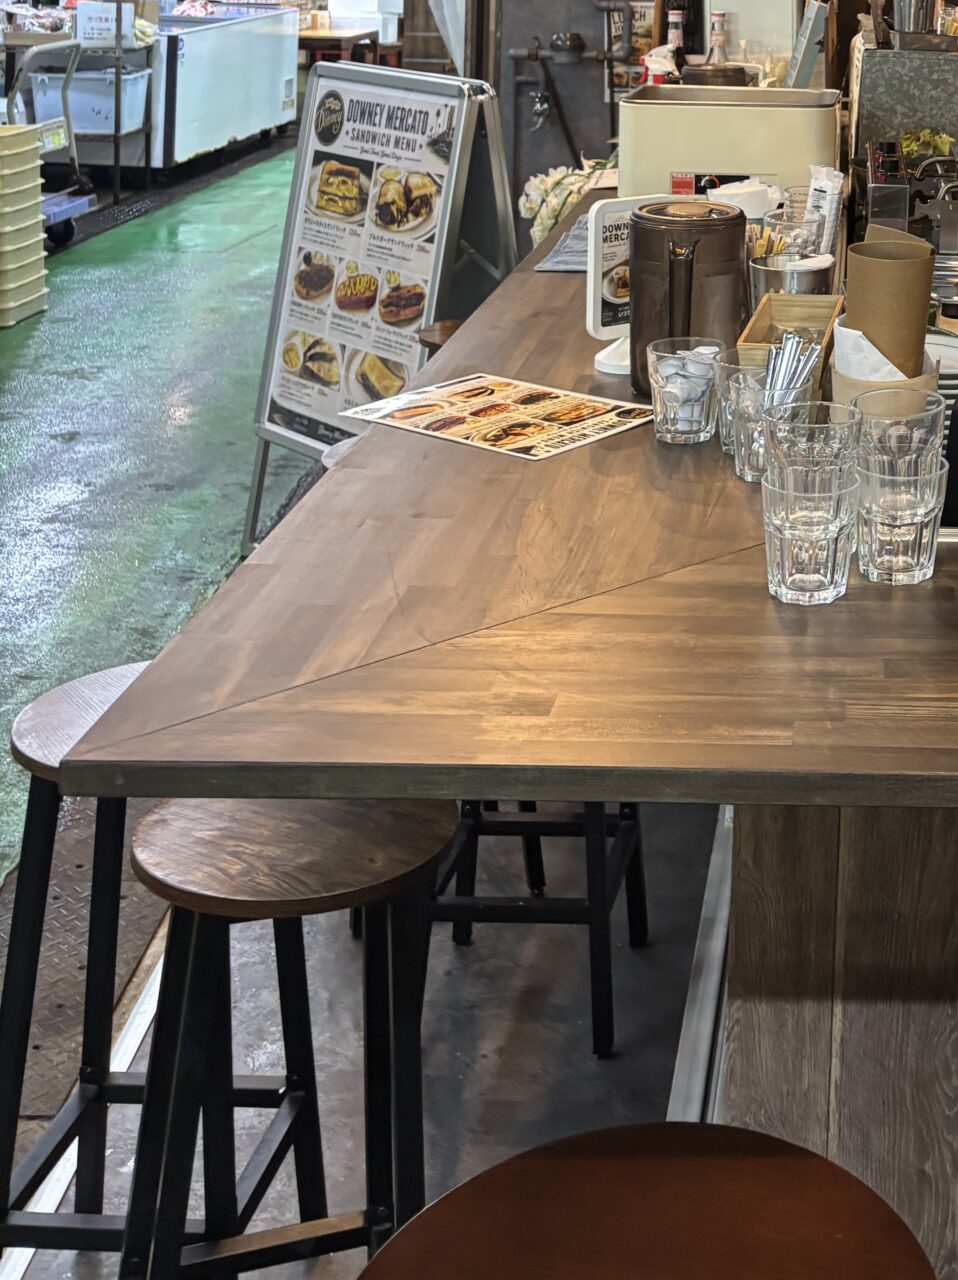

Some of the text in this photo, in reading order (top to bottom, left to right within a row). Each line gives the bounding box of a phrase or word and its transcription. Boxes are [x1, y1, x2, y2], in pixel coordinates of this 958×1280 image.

[611, 10, 646, 25] LUCH
[346, 98, 430, 136] DOWNEY MERCATO
[351, 127, 418, 153] SANDWICH MENU
[602, 222, 630, 234] DOWN
[602, 231, 631, 243] MERCA
